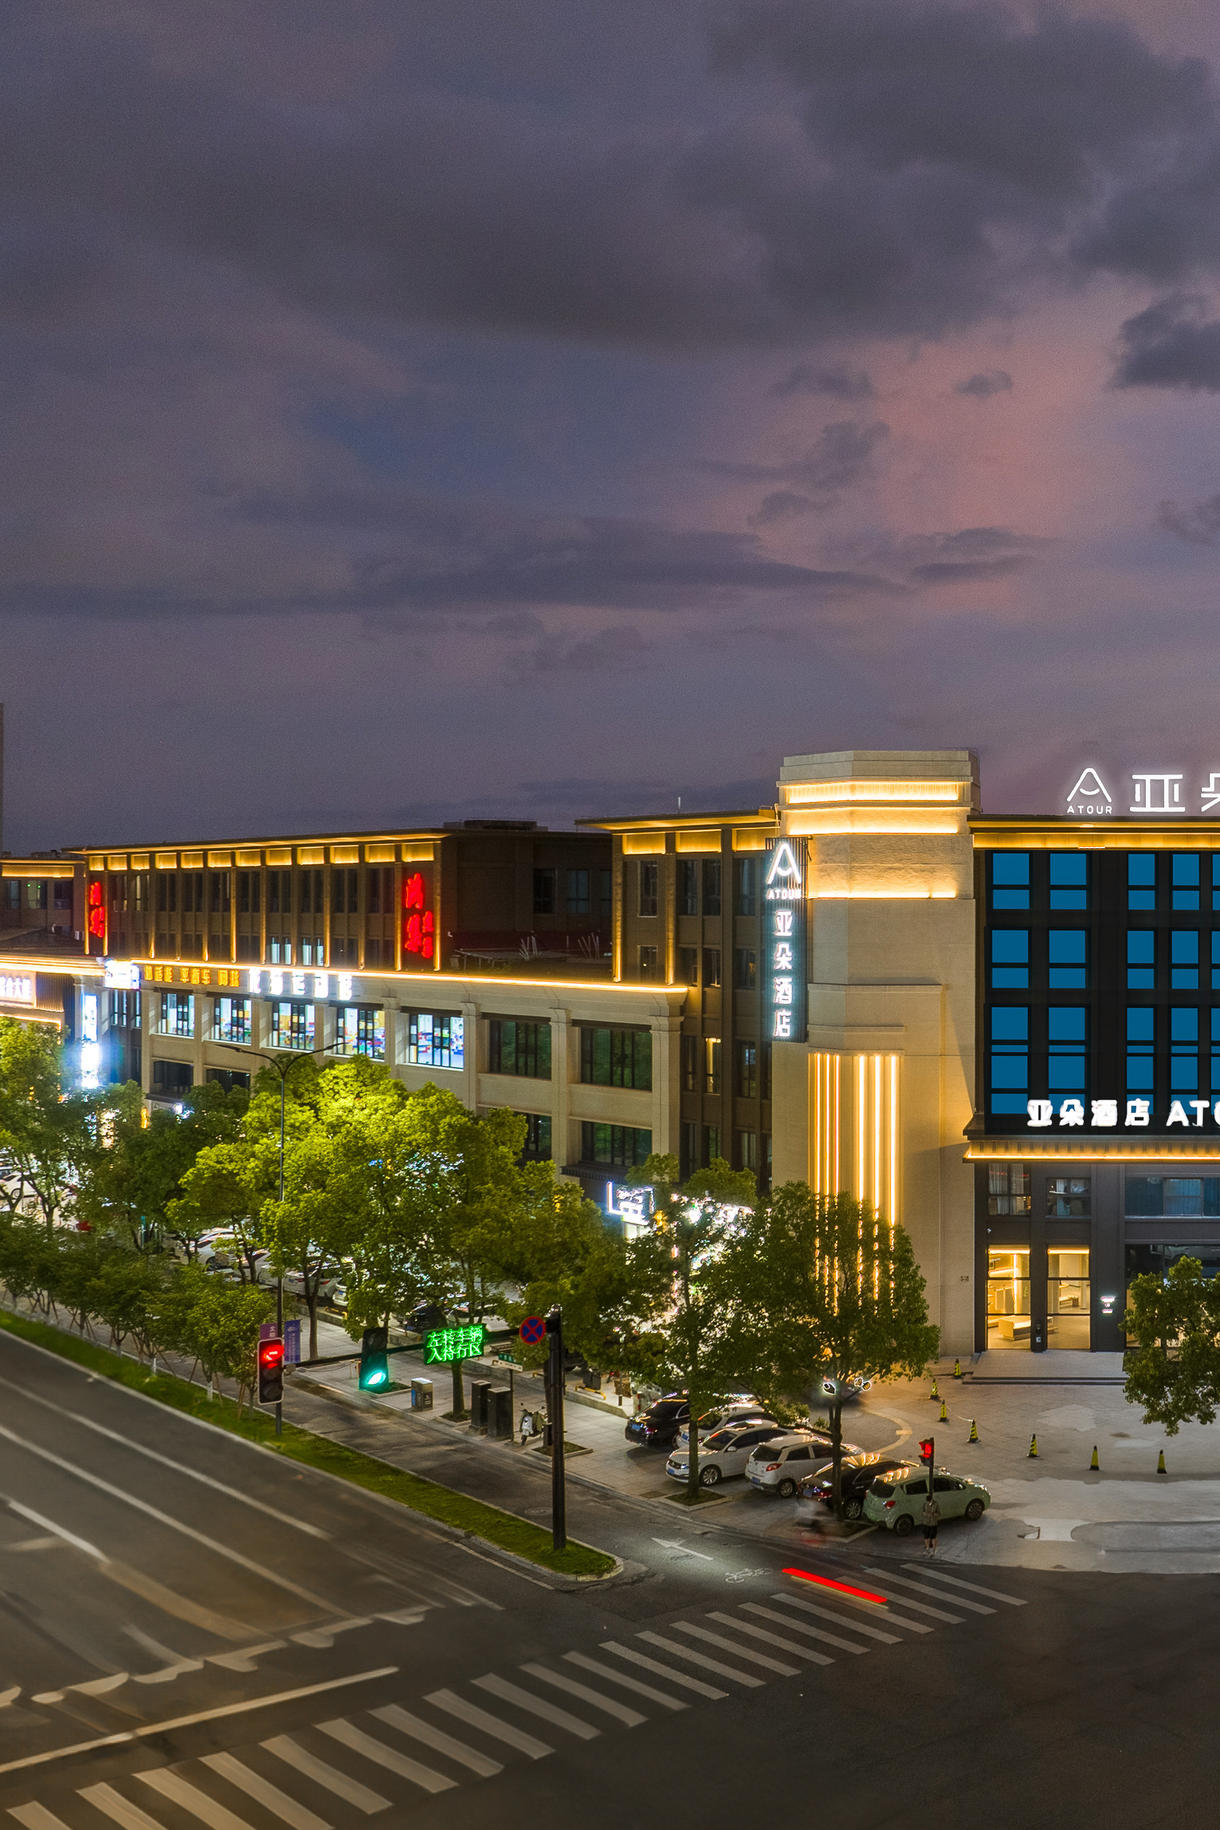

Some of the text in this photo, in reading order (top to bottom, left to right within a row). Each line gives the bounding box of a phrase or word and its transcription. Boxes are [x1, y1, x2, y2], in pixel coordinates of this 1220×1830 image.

[1067, 805, 1113, 815] ATOUR
[773, 910, 794, 1037] 亚朵酒店
[1027, 1099, 1150, 1128] 亚朵酒店
[427, 1326, 483, 1348] 左转车辆
[427, 1343, 482, 1364] 入待行区
